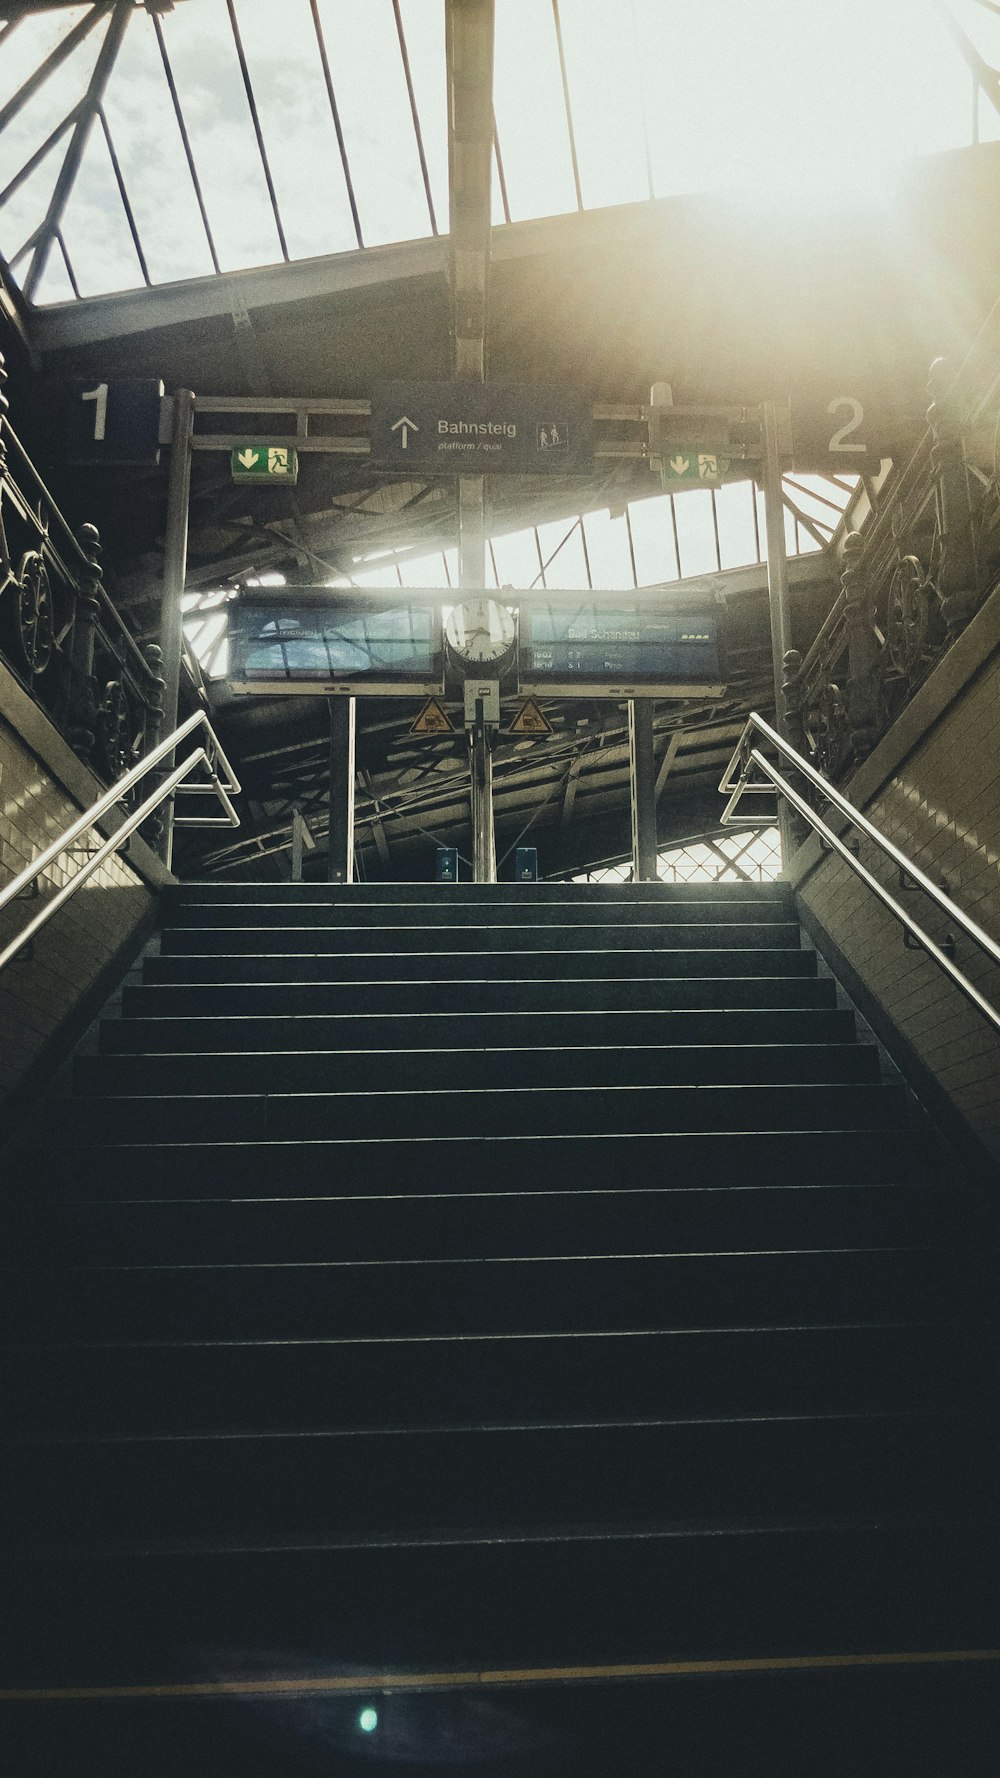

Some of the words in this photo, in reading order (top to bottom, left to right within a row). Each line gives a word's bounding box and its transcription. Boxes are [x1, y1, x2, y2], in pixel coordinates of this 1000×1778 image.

[82, 383, 108, 440] 1
[438, 420, 516, 438] Bahnsteig
[827, 397, 867, 452] 2
[438, 442, 475, 451] platform
[484, 442, 502, 452] quai
[568, 628, 587, 639] Bad
[591, 629, 640, 640] Schandau
[568, 661, 573, 669] S
